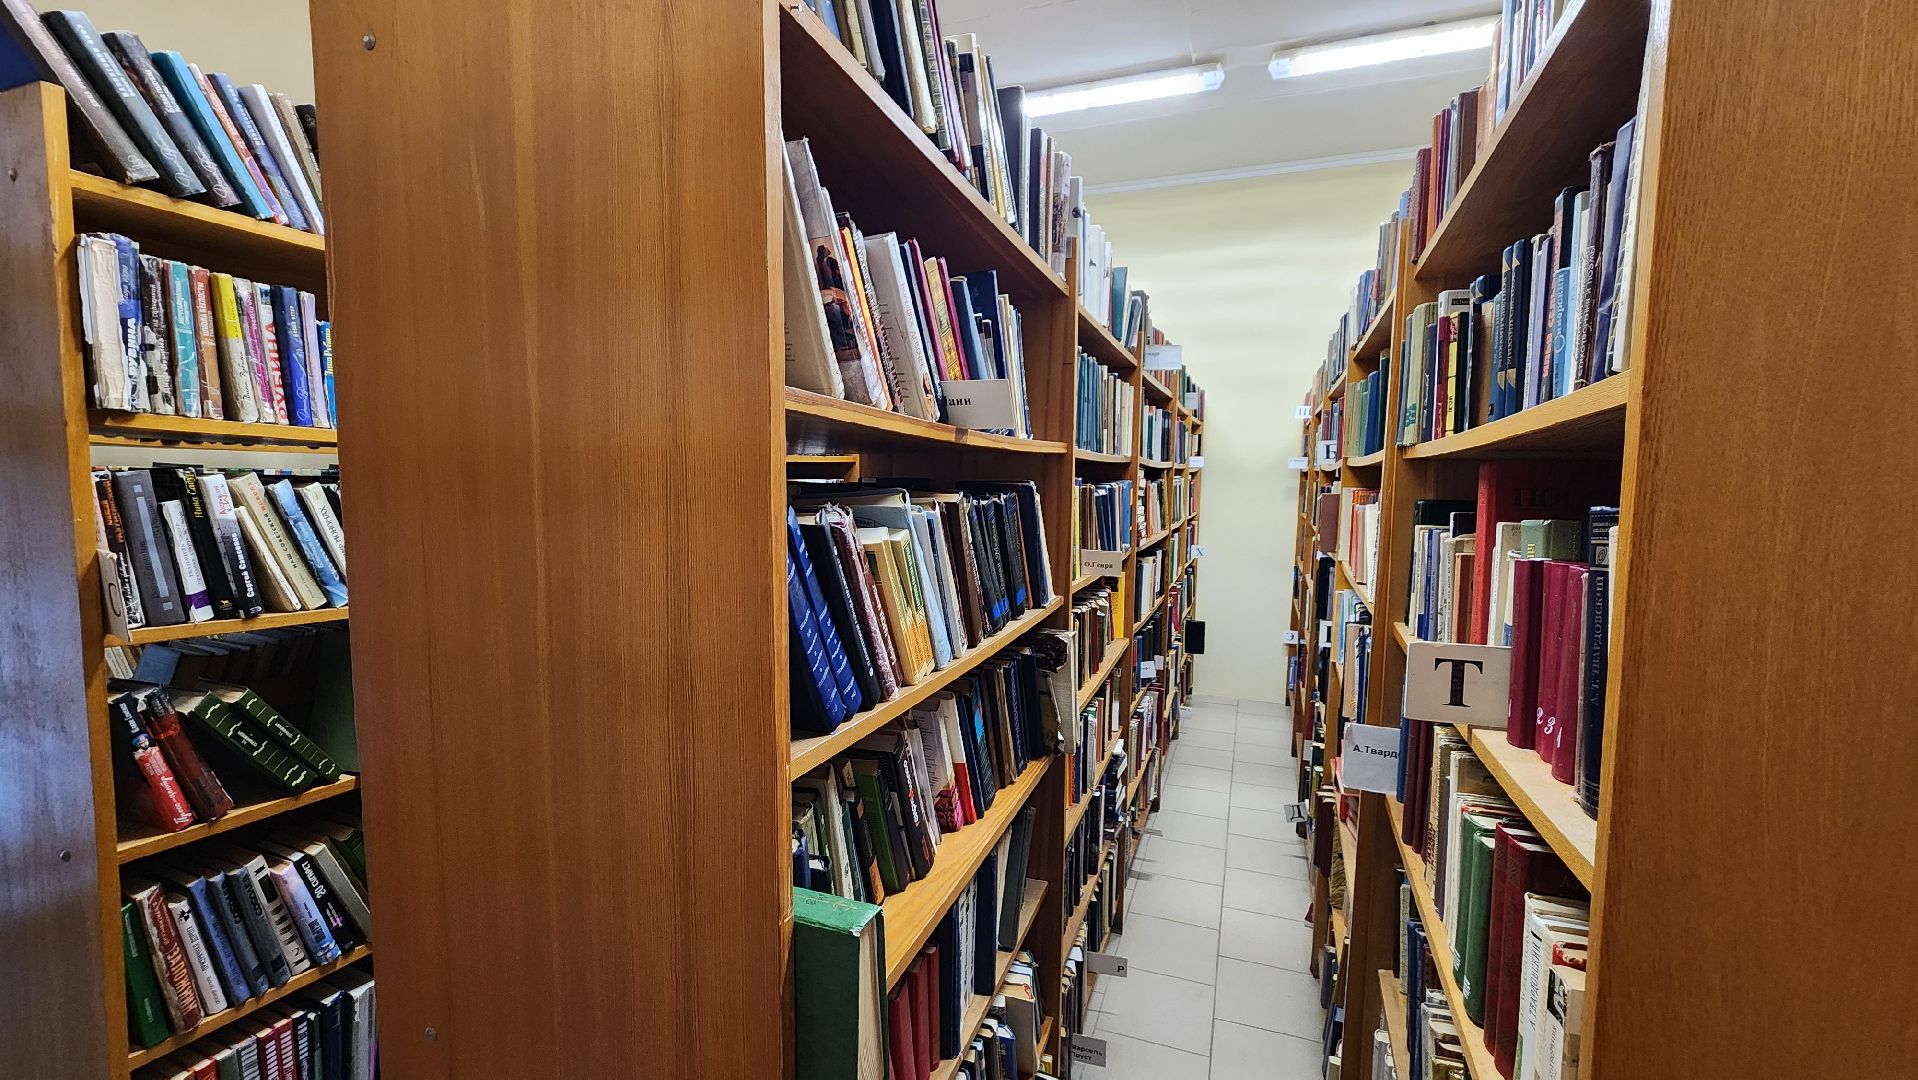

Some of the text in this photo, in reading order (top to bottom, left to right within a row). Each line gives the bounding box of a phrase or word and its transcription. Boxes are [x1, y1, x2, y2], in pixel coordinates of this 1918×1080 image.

[1324, 444, 1337, 460] Б
[285, 552, 298, 569] НАШ
[1590, 574, 1604, 677] ТВАРДОВСКИЙ
[1434, 657, 1484, 707] Т
[1529, 941, 1541, 1018] ТВАРДОВСКИЙ
